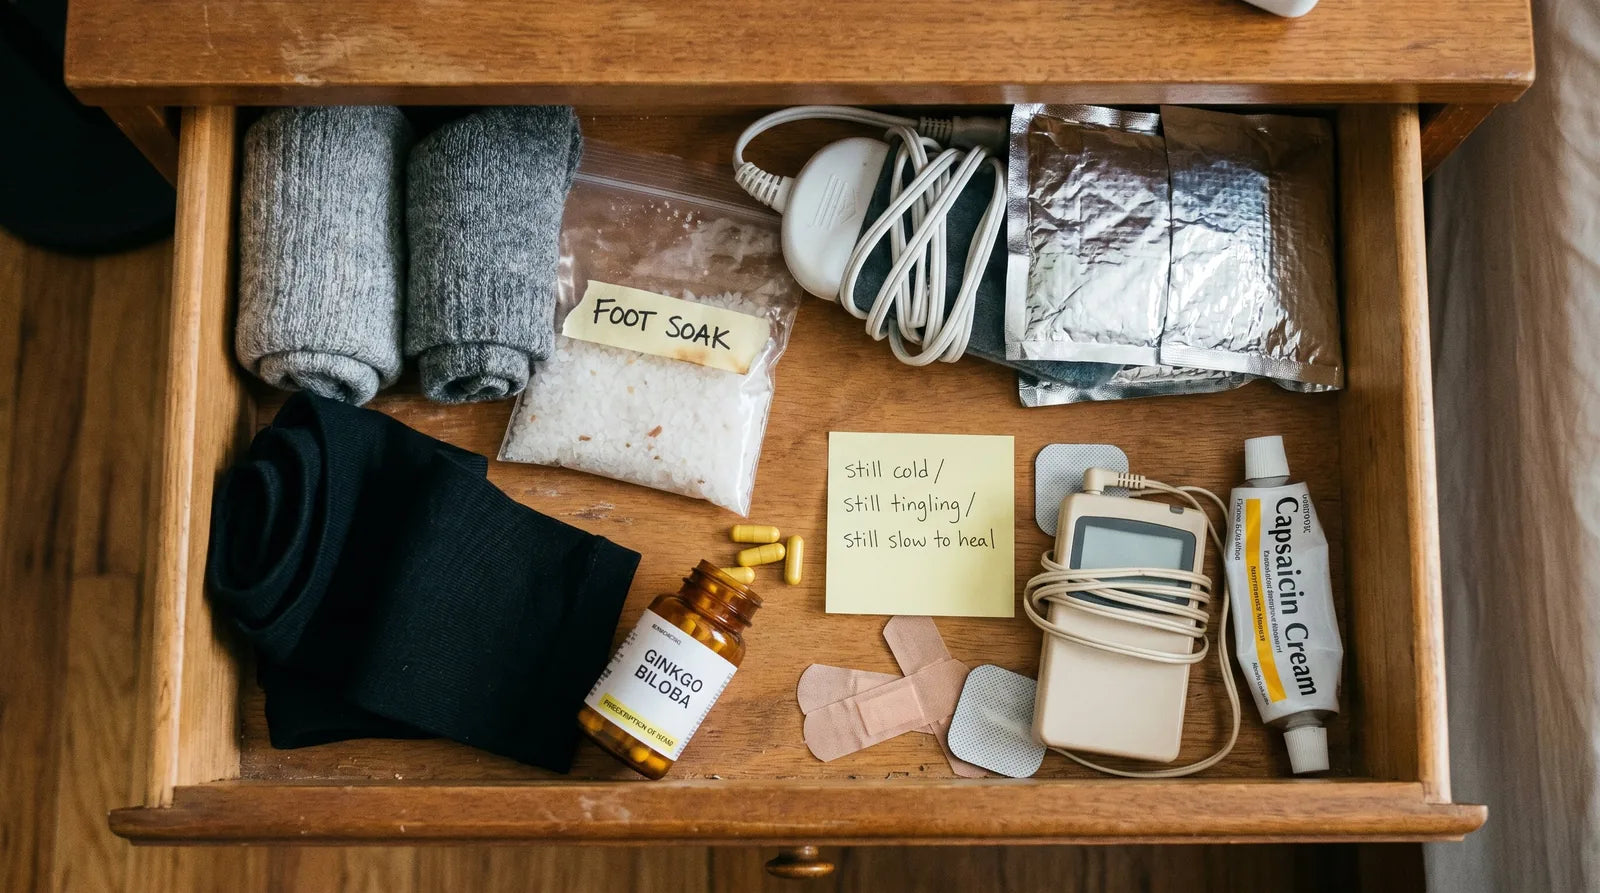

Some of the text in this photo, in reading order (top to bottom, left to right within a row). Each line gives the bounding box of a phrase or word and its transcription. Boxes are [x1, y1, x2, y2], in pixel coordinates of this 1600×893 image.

[593, 298, 731, 350] FOOT SOAK
[845, 459, 882, 478] still
[843, 493, 881, 512] still
[843, 528, 995, 549] still slow to heal
[1268, 496, 1305, 615] Capsaicin
[644, 648, 703, 693] GINKGO
[1285, 622, 1317, 696] Cream
[634, 664, 692, 709] BILOBA
